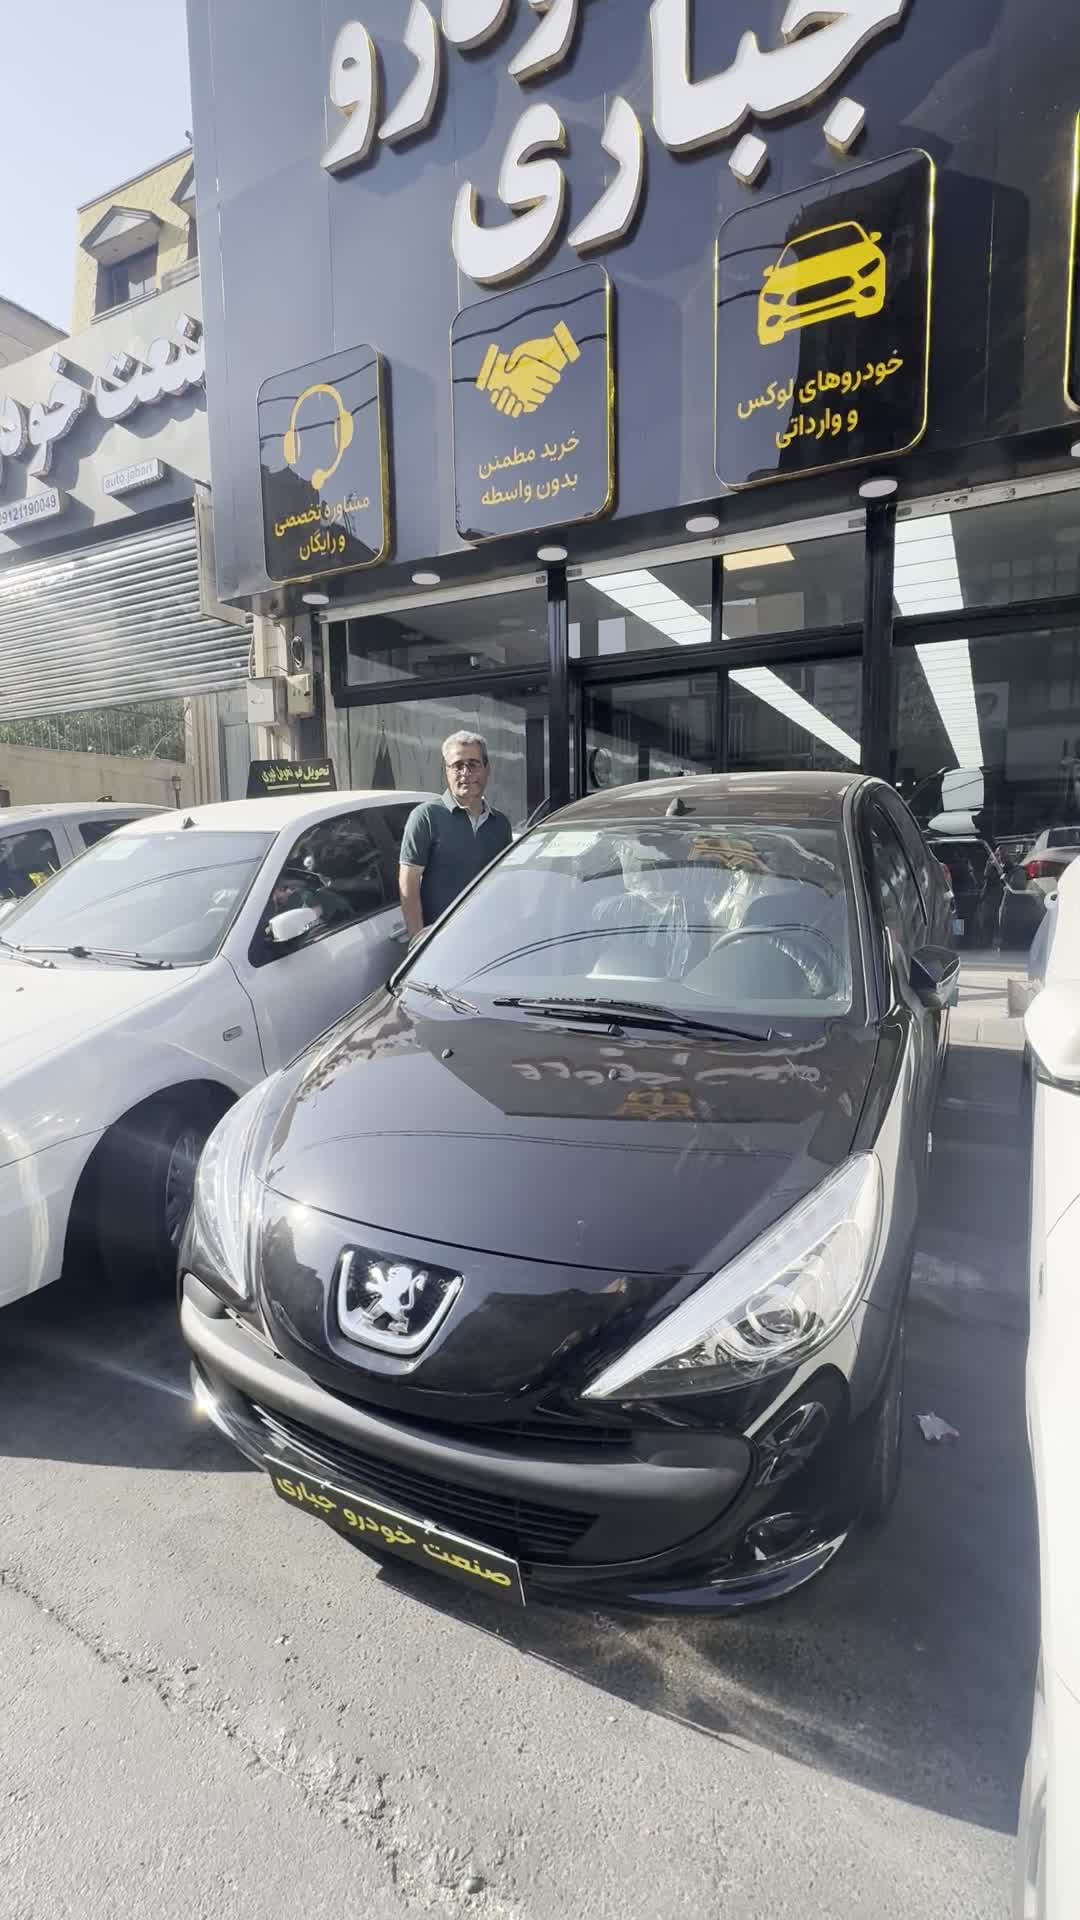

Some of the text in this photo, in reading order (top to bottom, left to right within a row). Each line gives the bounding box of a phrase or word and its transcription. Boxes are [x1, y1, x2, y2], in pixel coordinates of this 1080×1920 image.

[737, 350, 904, 419] خودروهای لوکس
[540, 430, 580, 462] خرید
[775, 407, 859, 449] و وارداتی
[481, 473, 578, 505] بدون واسطه
[0, 494, 57, 525] 9121190049
[274, 491, 370, 537] مشاوره تخصصی
[299, 528, 346, 561] و رایگان
[276, 1477, 512, 1588] صنعت خودرو جباری
